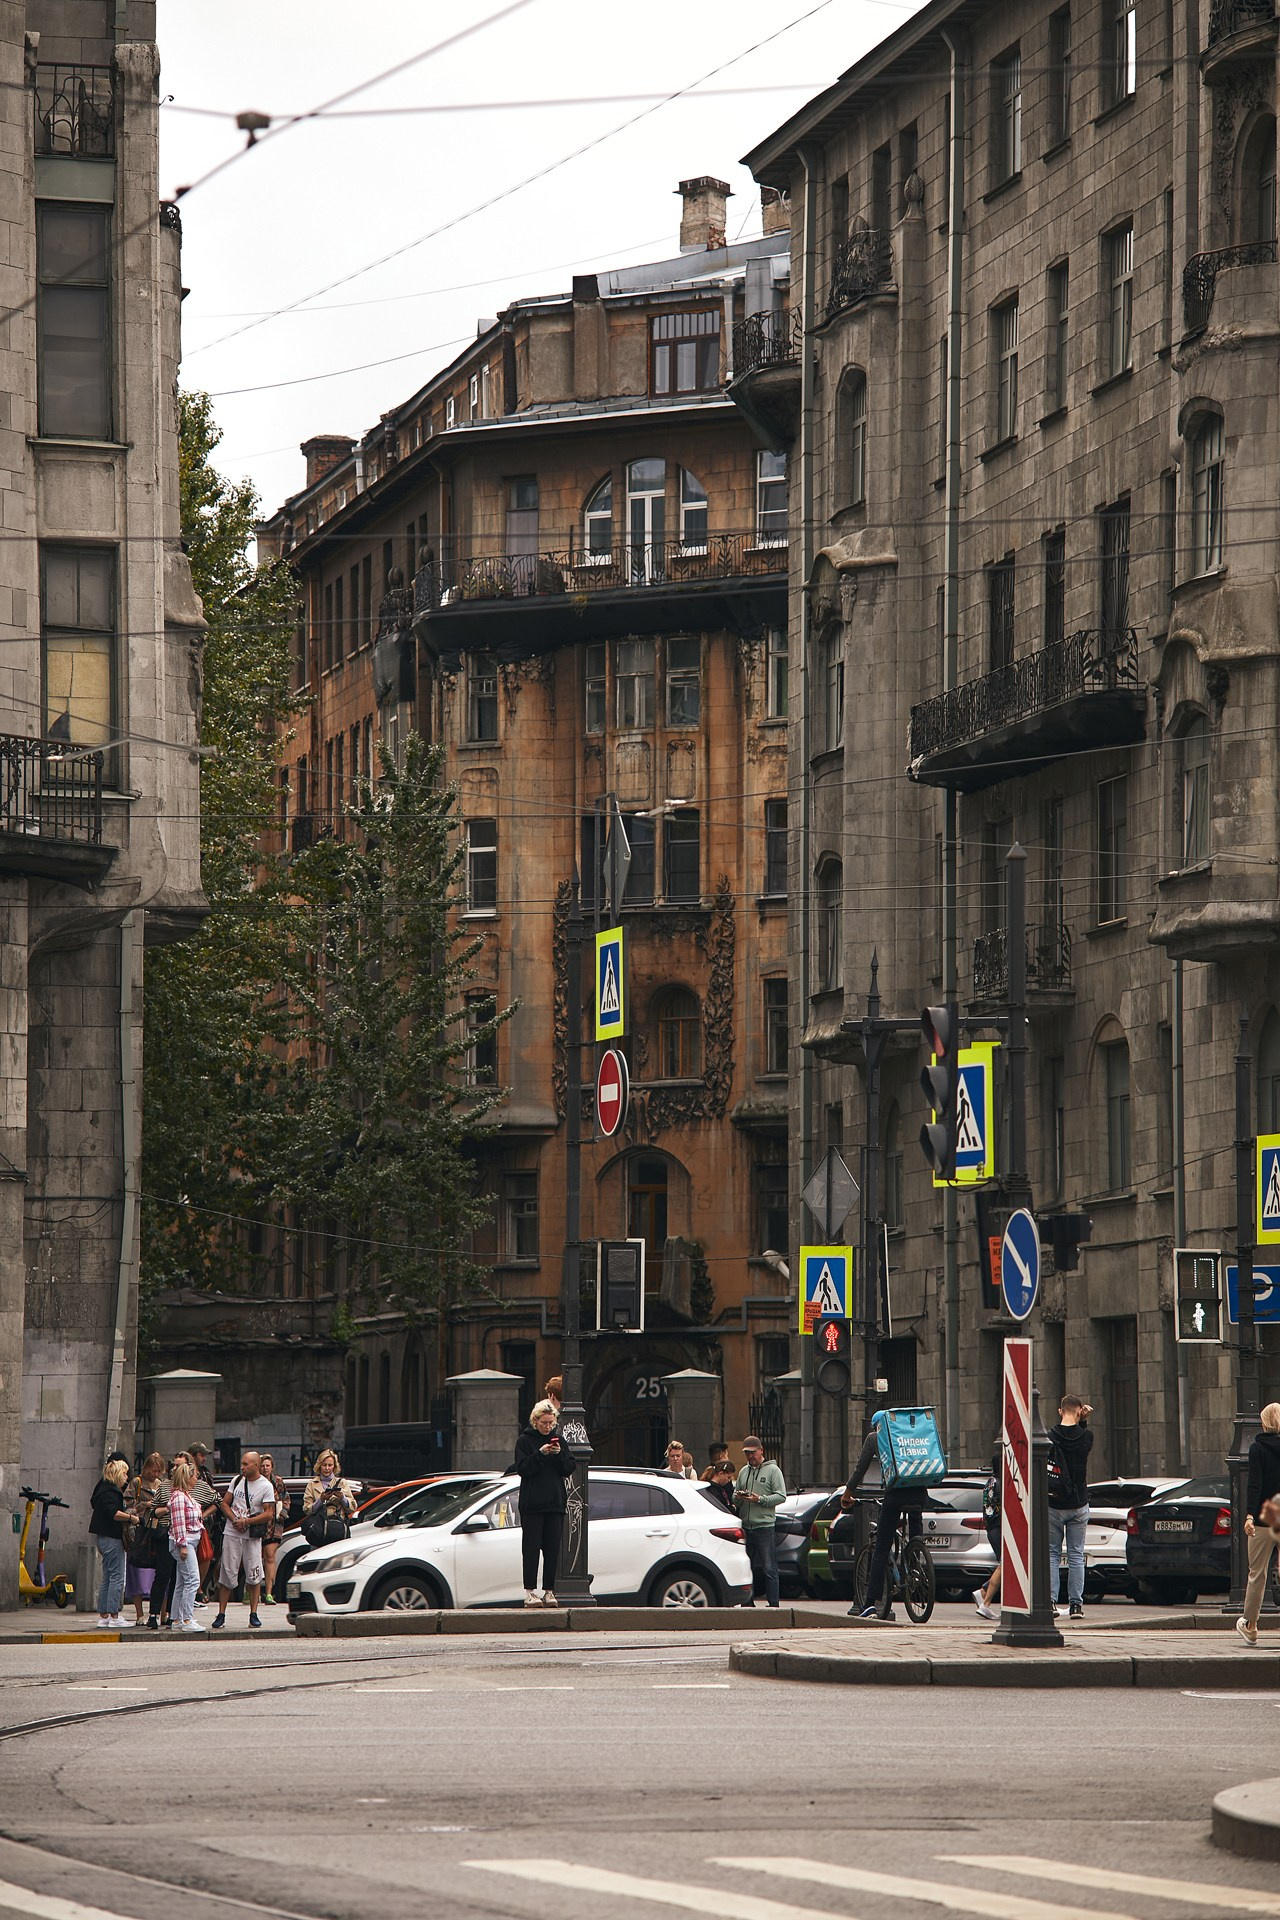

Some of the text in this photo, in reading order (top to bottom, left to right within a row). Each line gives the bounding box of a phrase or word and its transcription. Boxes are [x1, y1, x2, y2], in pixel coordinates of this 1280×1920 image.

[1193, 1257, 1215, 1289] 17
[635, 1376, 661, 1399] 25
[896, 1436, 931, 1447] Яндекс
[899, 1446, 929, 1457] Лавка
